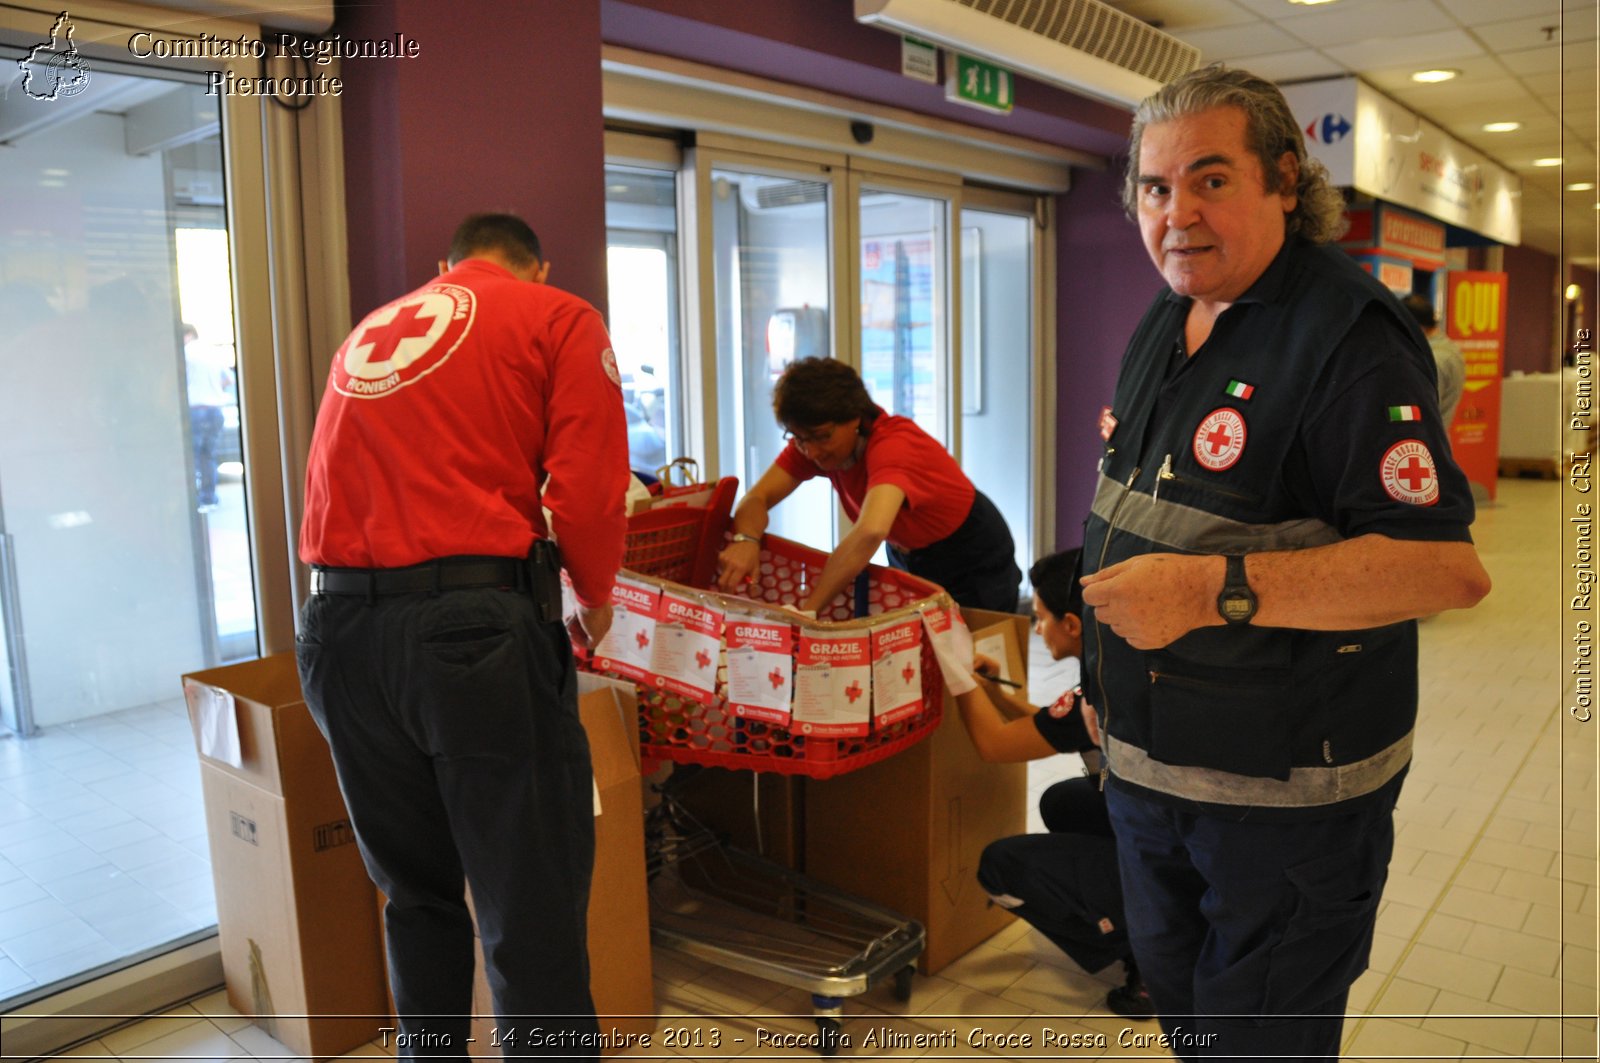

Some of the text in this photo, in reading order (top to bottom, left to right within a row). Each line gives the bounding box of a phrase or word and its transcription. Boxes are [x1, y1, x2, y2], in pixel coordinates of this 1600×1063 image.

[1455, 280, 1499, 336] QUI
[1384, 456, 1398, 480] CROCE
[1395, 444, 1419, 457] ROSSA
[612, 586, 652, 607] GRAZIE.
[669, 602, 715, 626] GRAZIE.
[735, 626, 782, 641] GRAZIE.
[879, 626, 914, 645] GRAZIE.
[810, 642, 862, 655] GRAZIE.
